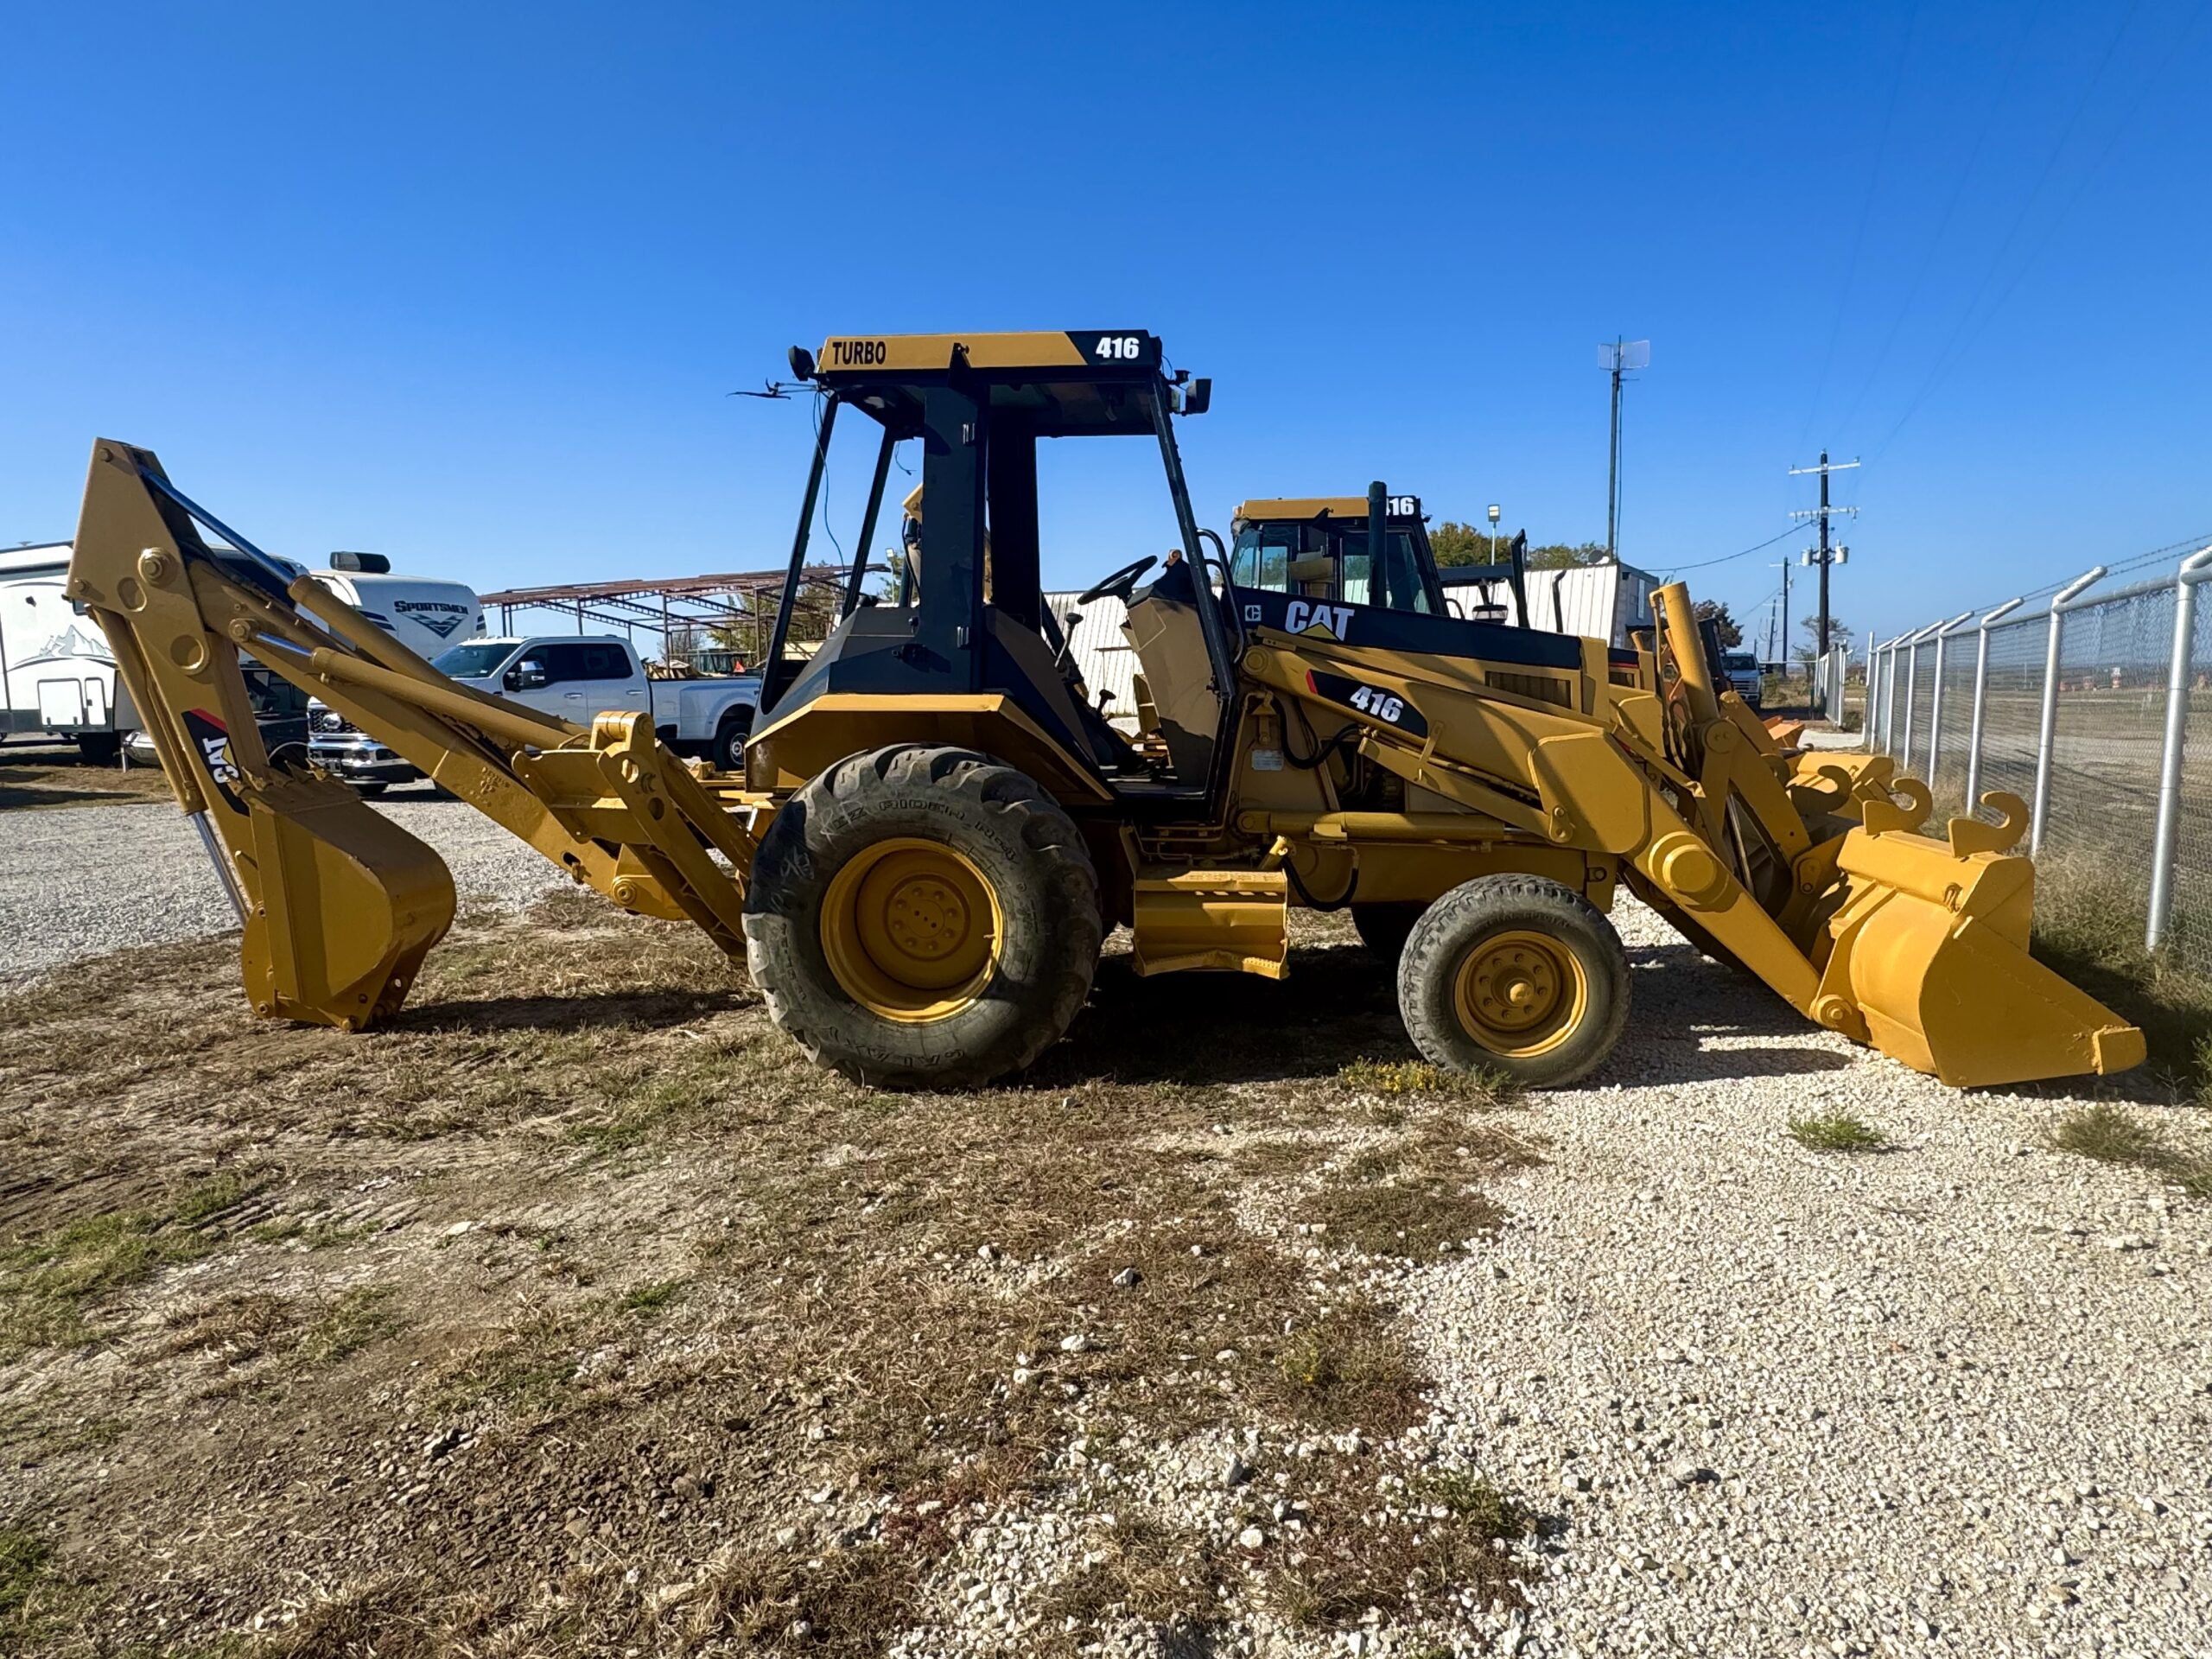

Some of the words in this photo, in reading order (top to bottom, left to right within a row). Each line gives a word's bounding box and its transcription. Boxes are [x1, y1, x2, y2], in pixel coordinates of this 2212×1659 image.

[832, 341, 887, 365] TURBO
[1096, 337, 1140, 359] 416
[1285, 601, 1355, 641] CAT
[1350, 685, 1404, 722] 416
[202, 737, 239, 784] CAT
